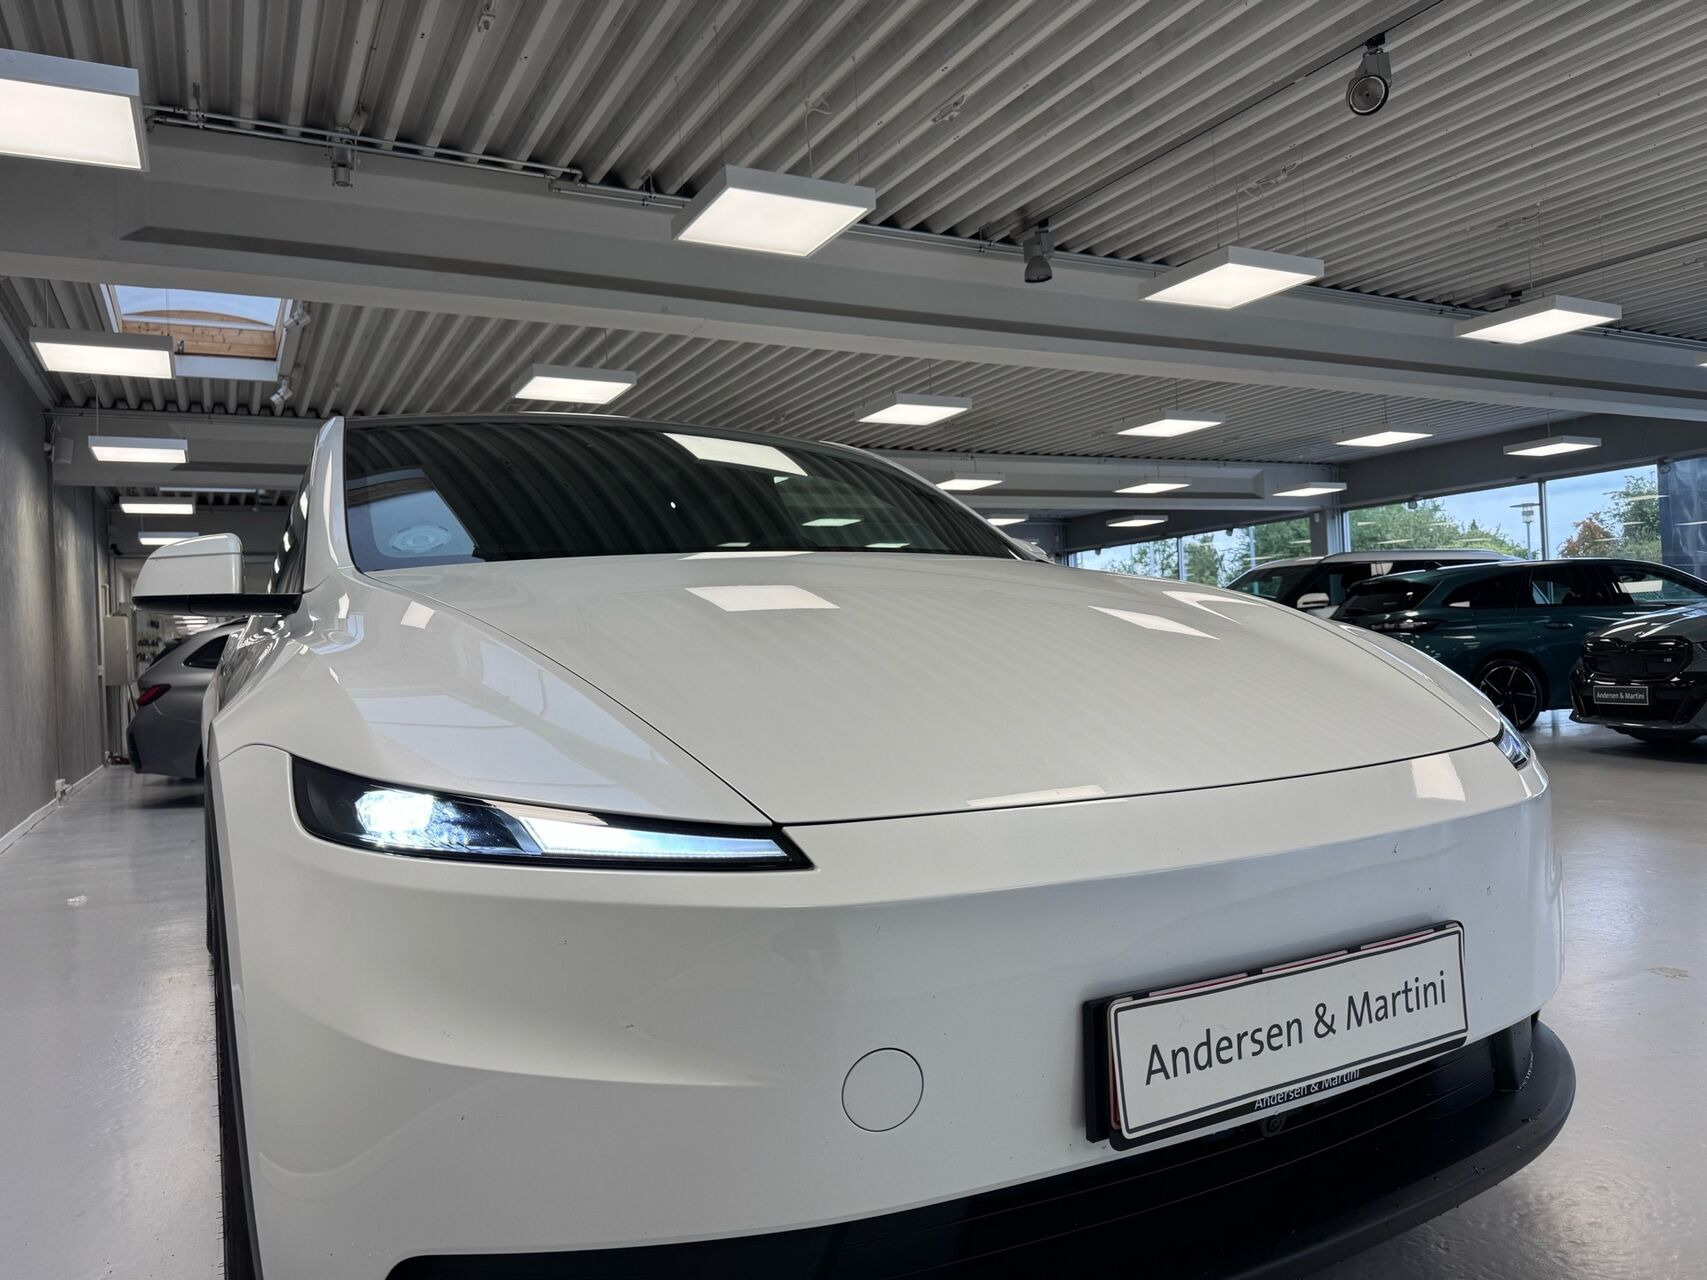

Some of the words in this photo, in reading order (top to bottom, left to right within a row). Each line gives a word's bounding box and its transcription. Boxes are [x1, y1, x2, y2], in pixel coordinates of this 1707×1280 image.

[1597, 691, 1619, 699] Andersen
[1625, 692, 1645, 700] Martini
[1144, 1016, 1303, 1086] Andersen
[1313, 1002, 1337, 1039] &
[1345, 970, 1446, 1031] Martini
[1254, 1084, 1308, 1110] Andersen
[1310, 1082, 1319, 1093] &
[1321, 1069, 1360, 1090] Martini
